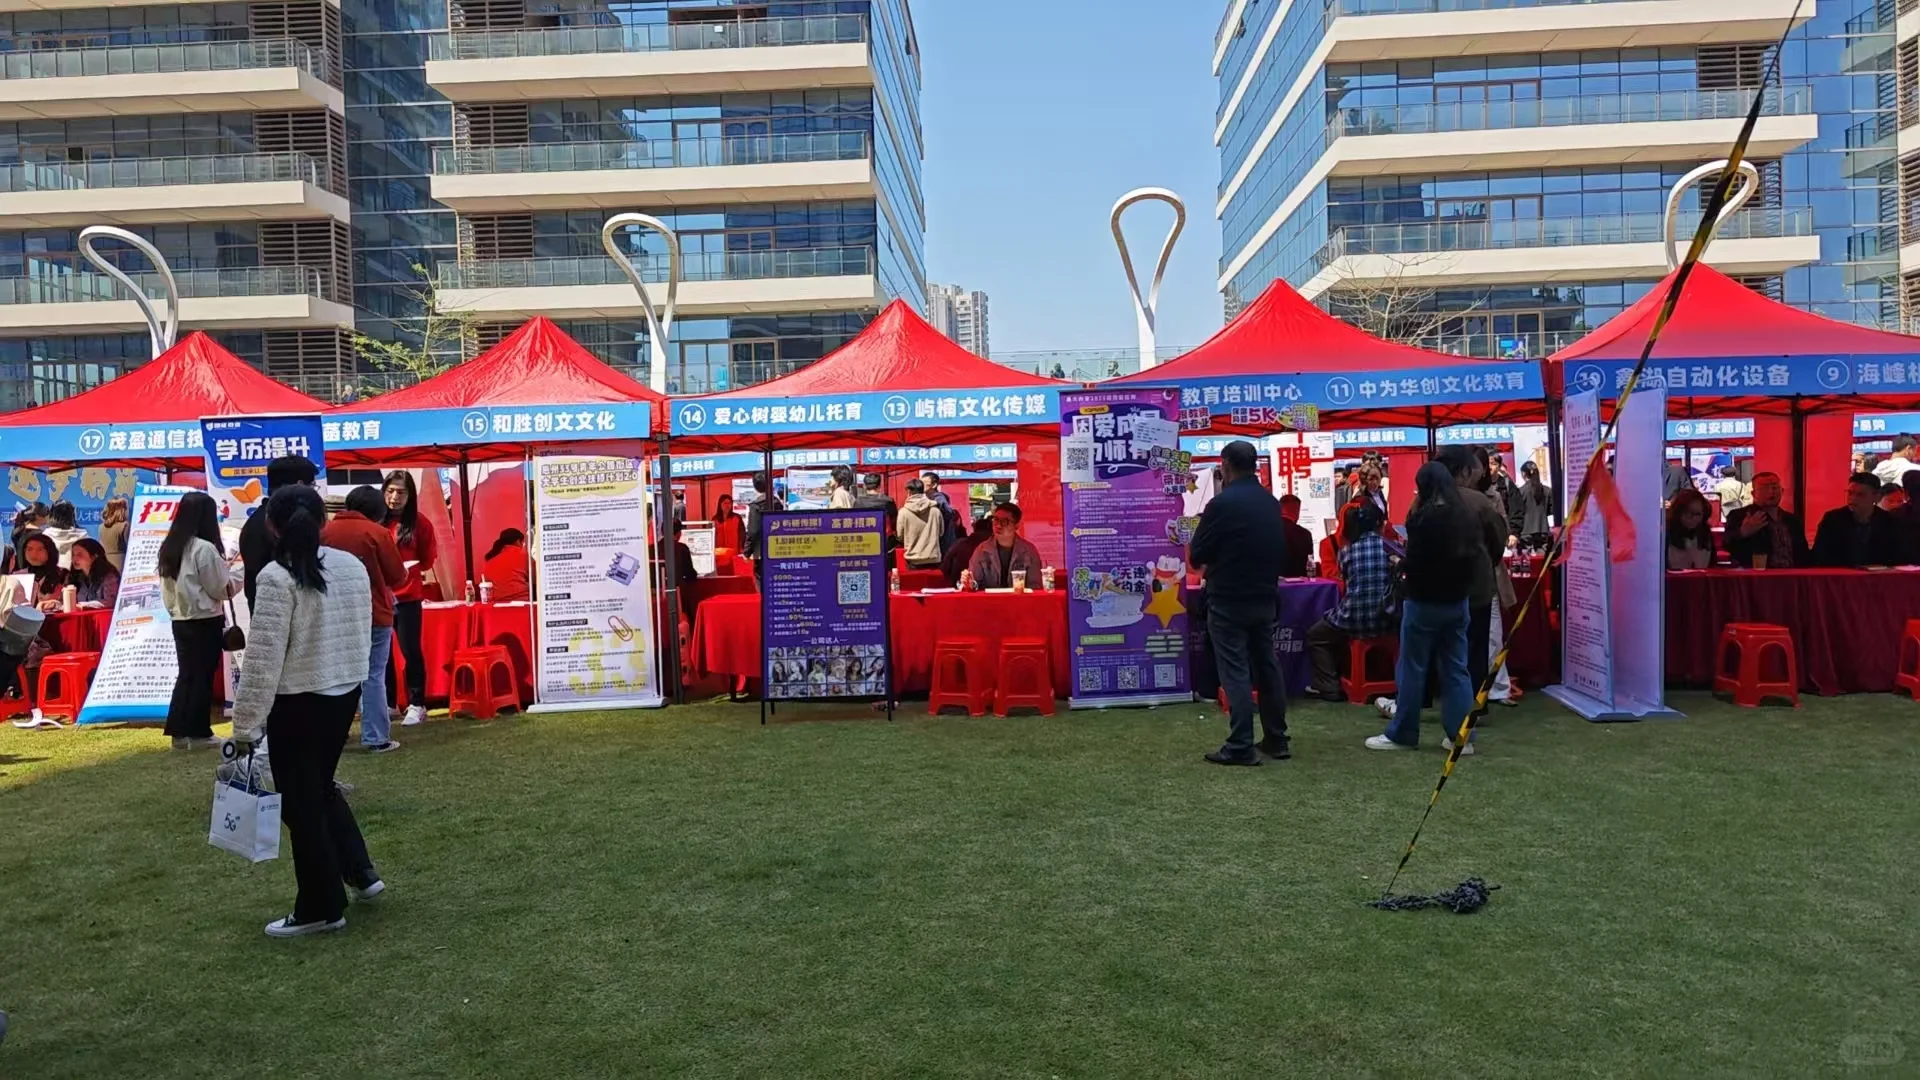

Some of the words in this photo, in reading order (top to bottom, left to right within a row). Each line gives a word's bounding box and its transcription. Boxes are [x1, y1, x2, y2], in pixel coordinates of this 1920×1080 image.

[1182, 383, 1303, 406] 教育培训中心
[1330, 383, 1349, 398] 11
[1359, 371, 1526, 399] 中为华创文化教育
[683, 410, 701, 424] 14
[714, 402, 862, 426] 爱心树婴幼儿托育
[887, 402, 906, 417] 13
[915, 394, 1046, 418] 屿楠文化传媒
[466, 417, 484, 432] 15
[493, 411, 616, 434] 和胜创文文化
[82, 435, 101, 449] 17
[215, 436, 310, 462] 学历提升
